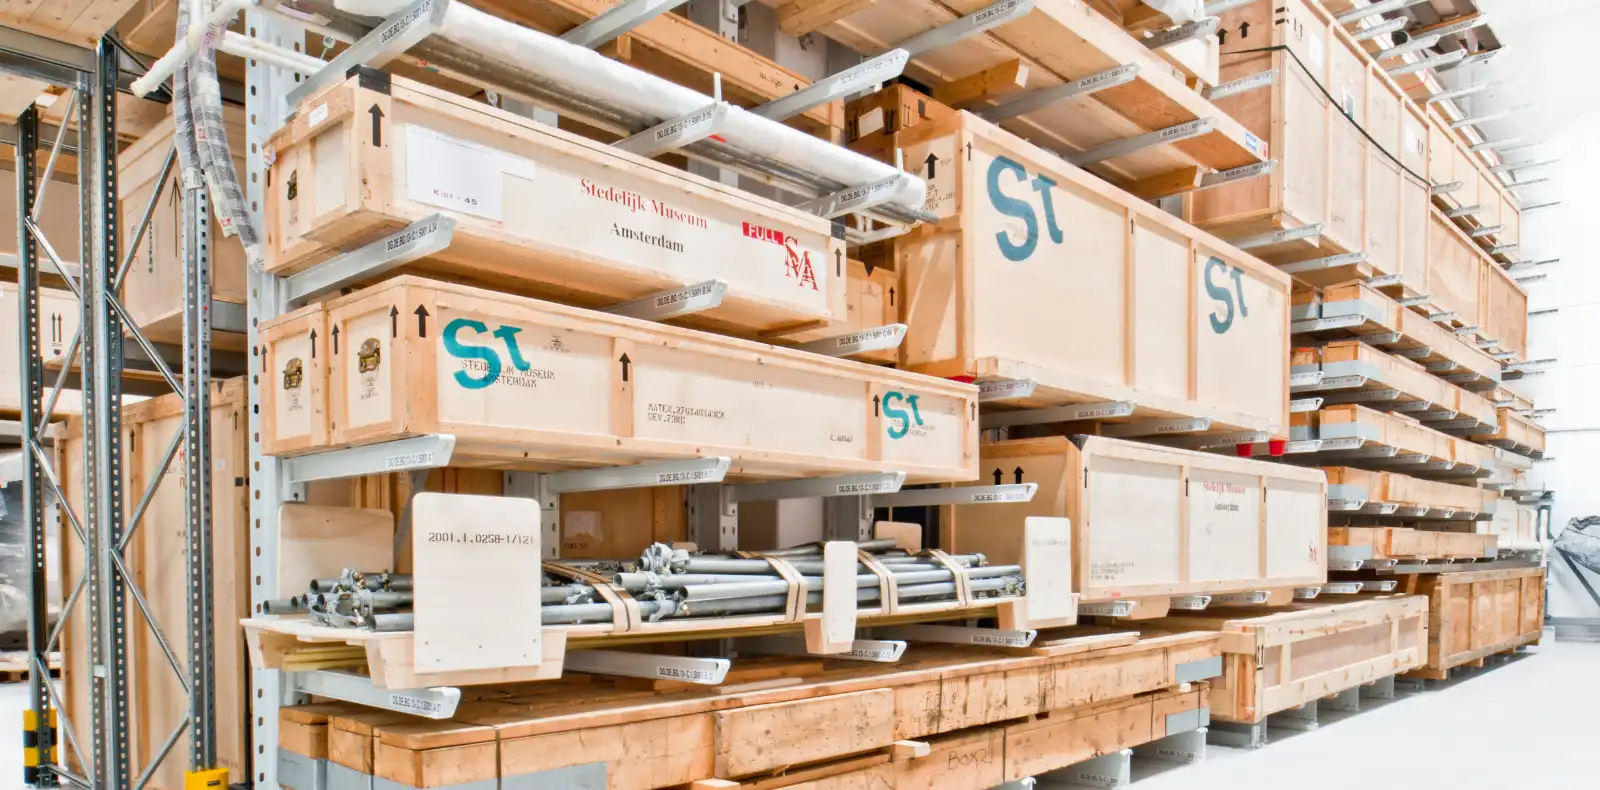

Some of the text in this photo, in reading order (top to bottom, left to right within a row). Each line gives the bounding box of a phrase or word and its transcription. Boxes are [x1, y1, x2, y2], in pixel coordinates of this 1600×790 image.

[580, 177, 708, 230] Stedelijk Museum
[609, 222, 685, 254] Amsterdam
[747, 223, 779, 245] FULL
[442, 317, 531, 390] St
